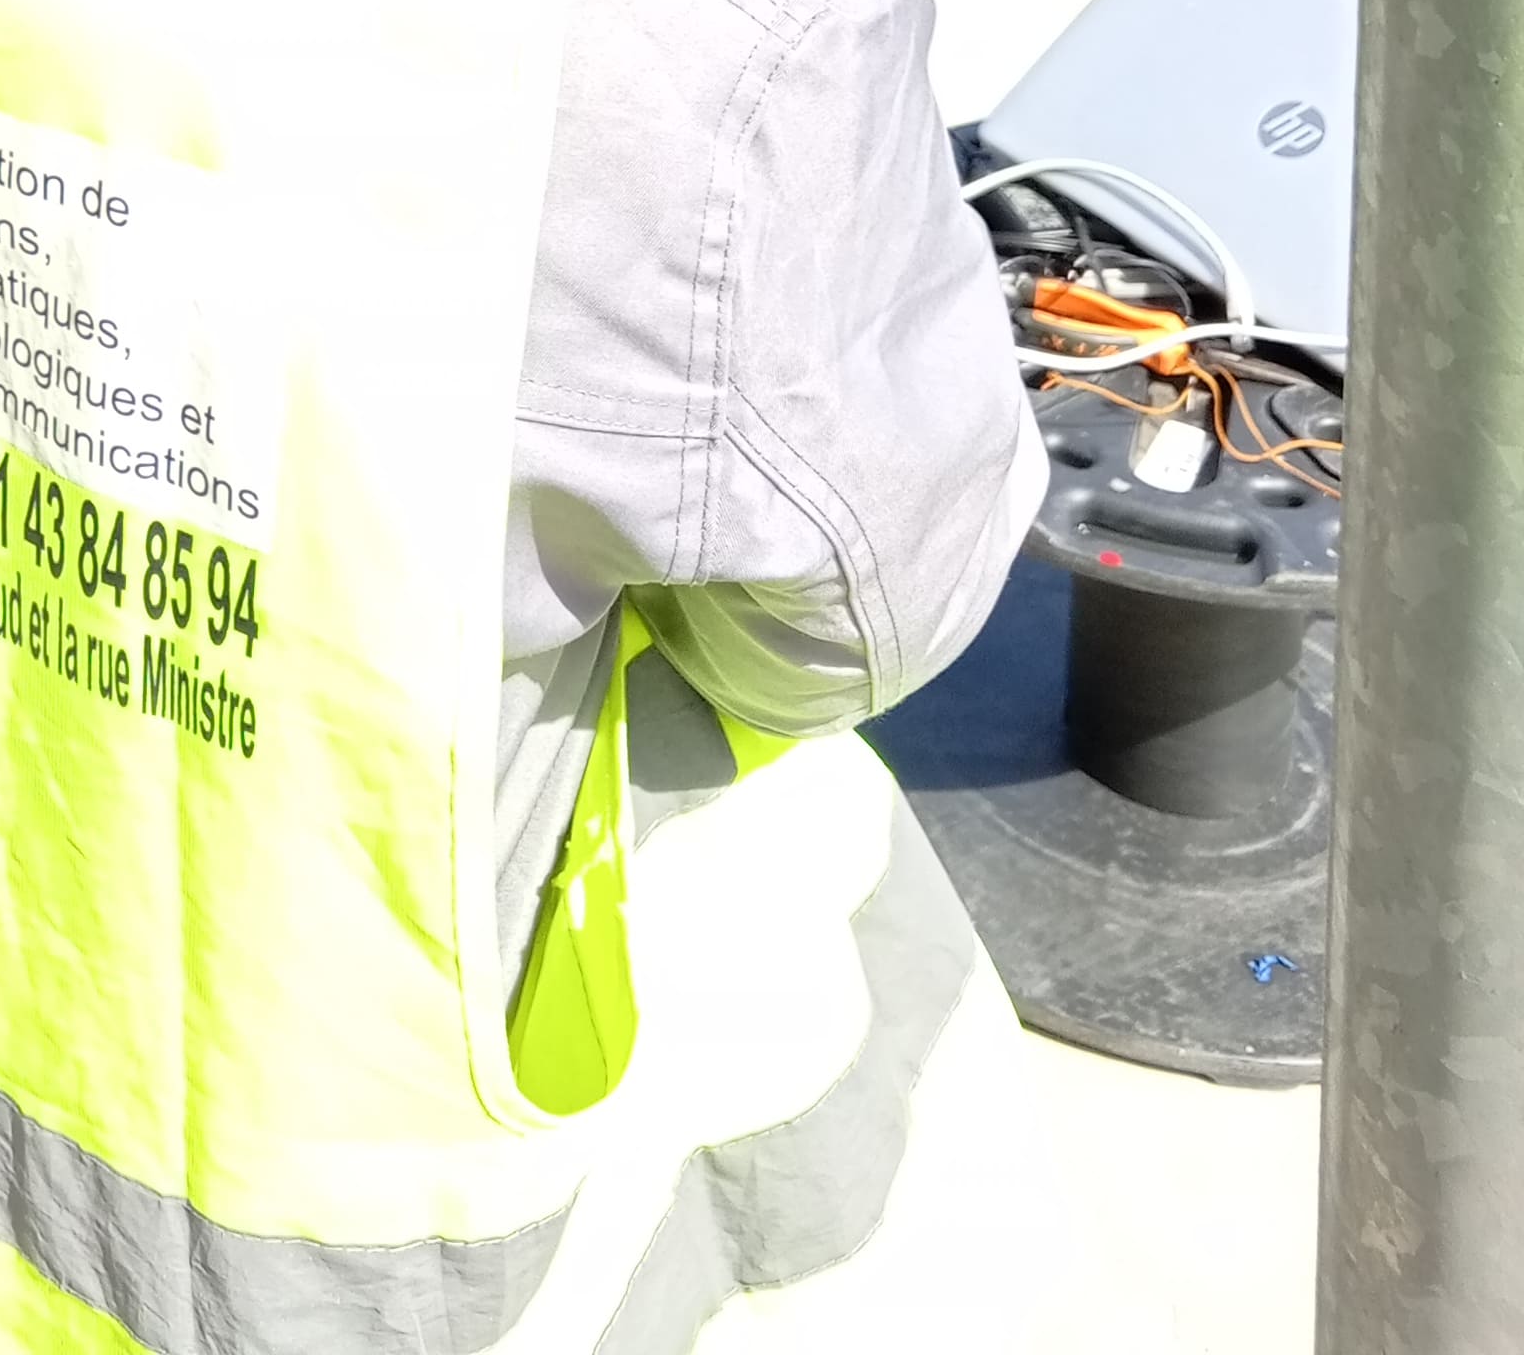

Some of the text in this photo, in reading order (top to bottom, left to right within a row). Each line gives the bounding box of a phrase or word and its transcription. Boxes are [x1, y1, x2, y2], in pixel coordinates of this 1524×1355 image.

[1263, 98, 1324, 155] hp
[81, 180, 130, 227] de
[180, 401, 216, 445] et
[23, 471, 66, 579] 43
[78, 499, 127, 608] 84
[143, 520, 194, 629] 85
[207, 545, 260, 658] 94
[28, 591, 51, 668] et
[57, 597, 79, 684] la
[87, 632, 130, 708] rue
[141, 634, 258, 759] Ministre
